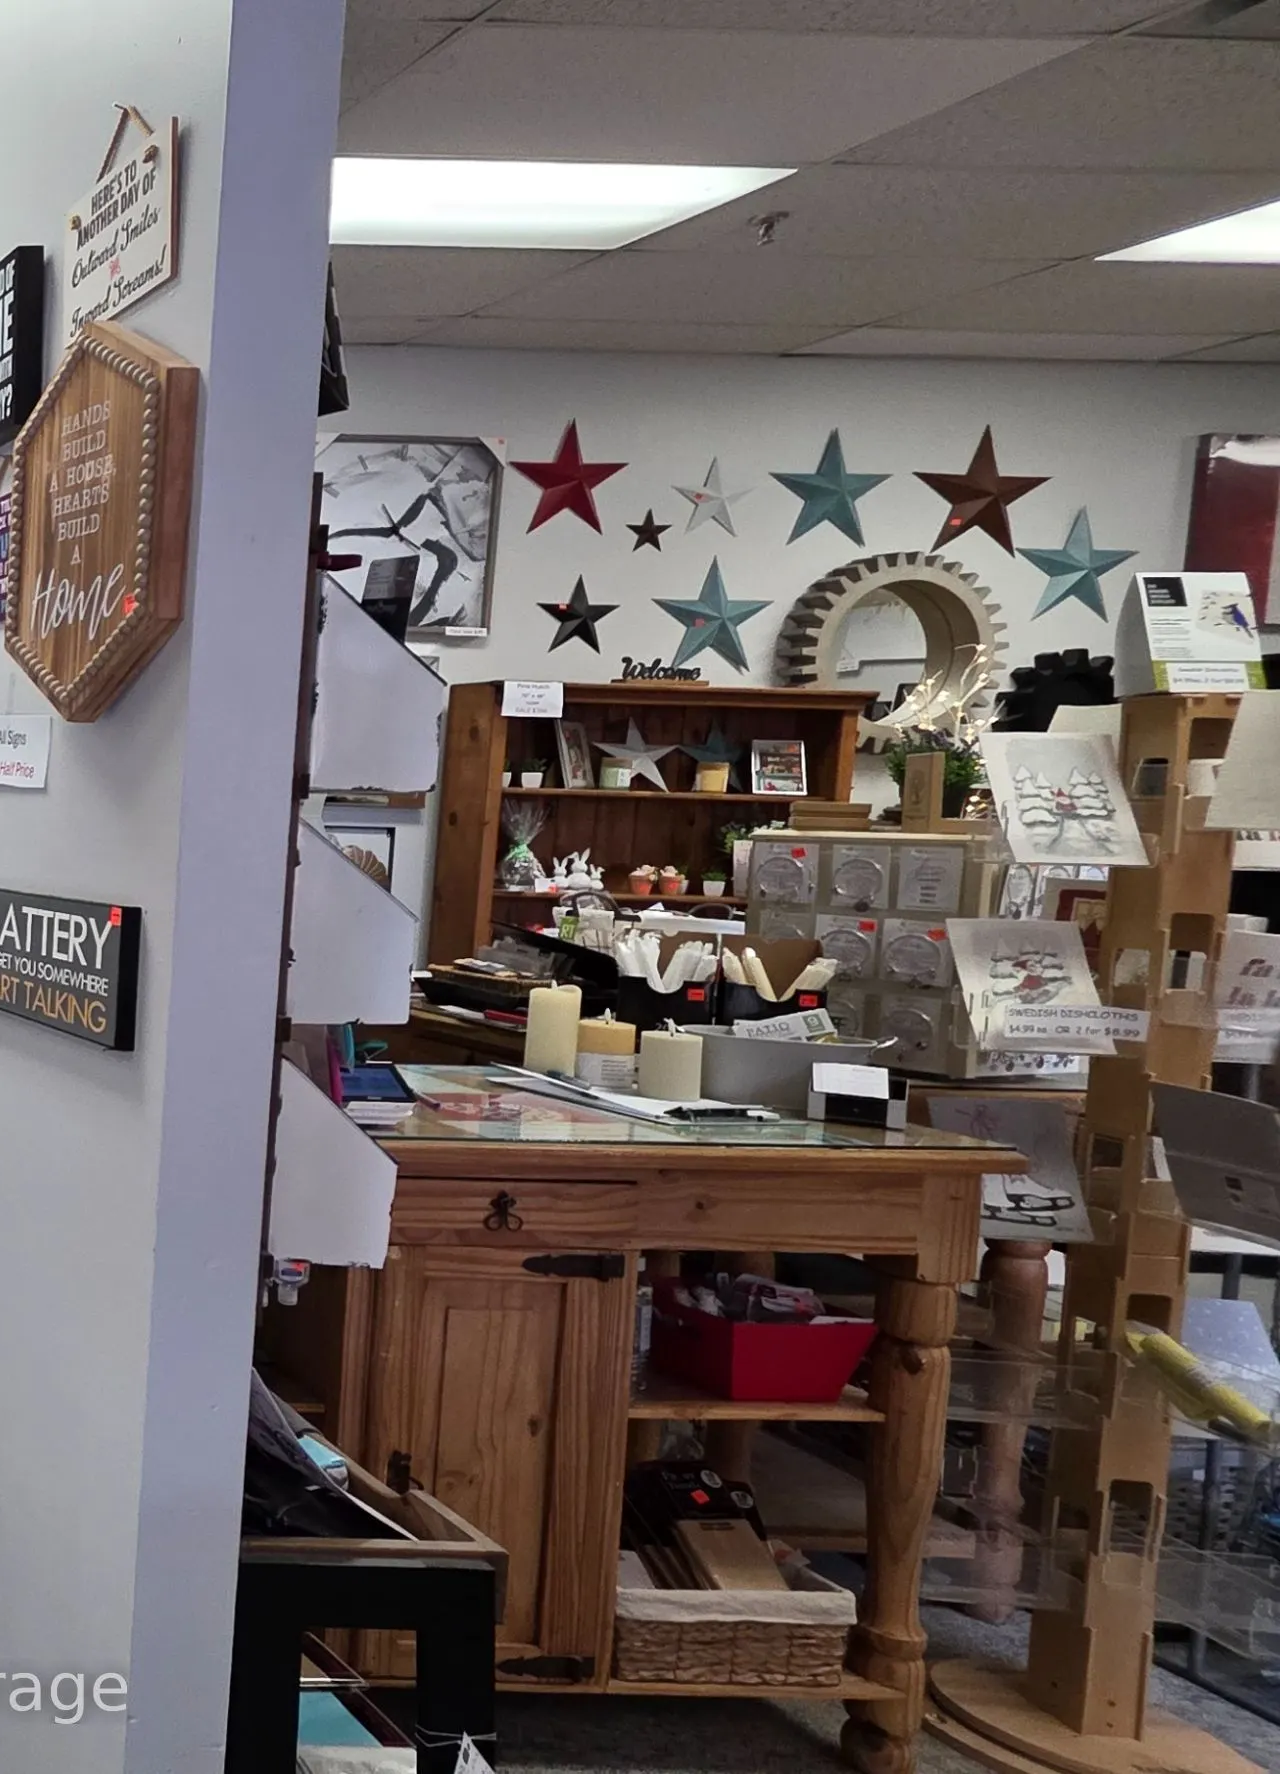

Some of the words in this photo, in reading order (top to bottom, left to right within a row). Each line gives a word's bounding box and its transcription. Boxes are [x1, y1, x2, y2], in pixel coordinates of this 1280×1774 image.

[91, 174, 123, 216] HERE'S
[125, 160, 138, 188] TO
[77, 197, 119, 251] ANOTHER
[120, 181, 140, 216] DAY
[142, 167, 156, 195] OF
[72, 229, 119, 287] Outward
[120, 203, 161, 251] Smiles
[113, 244, 168, 306] Screams!
[61, 400, 111, 437] HANDS
[62, 430, 106, 462] BUILD
[49, 471, 59, 493] A
[66, 453, 117, 486] HOUSE,
[53, 483, 109, 517] HEARTS
[57, 513, 100, 542] BUILD
[70, 544, 81, 565] A
[30, 563, 127, 640] Home
[621, 656, 701, 681] Welcome
[7, 730, 27, 749] Signs
[16, 761, 34, 779] Price
[14, 956, 36, 977] YOU
[37, 961, 109, 997] SOMEWHERE
[24, 980, 107, 1033] TALKING
[1009, 1008, 1058, 1018] SWEDISH
[1060, 1009, 1139, 1021] DISHCLOTHS
[1055, 1025, 1071, 1034] OR
[1076, 1026, 1082, 1035] 2
[1085, 1025, 1101, 1035] for
[1104, 1026, 1141, 1038] $8.99
